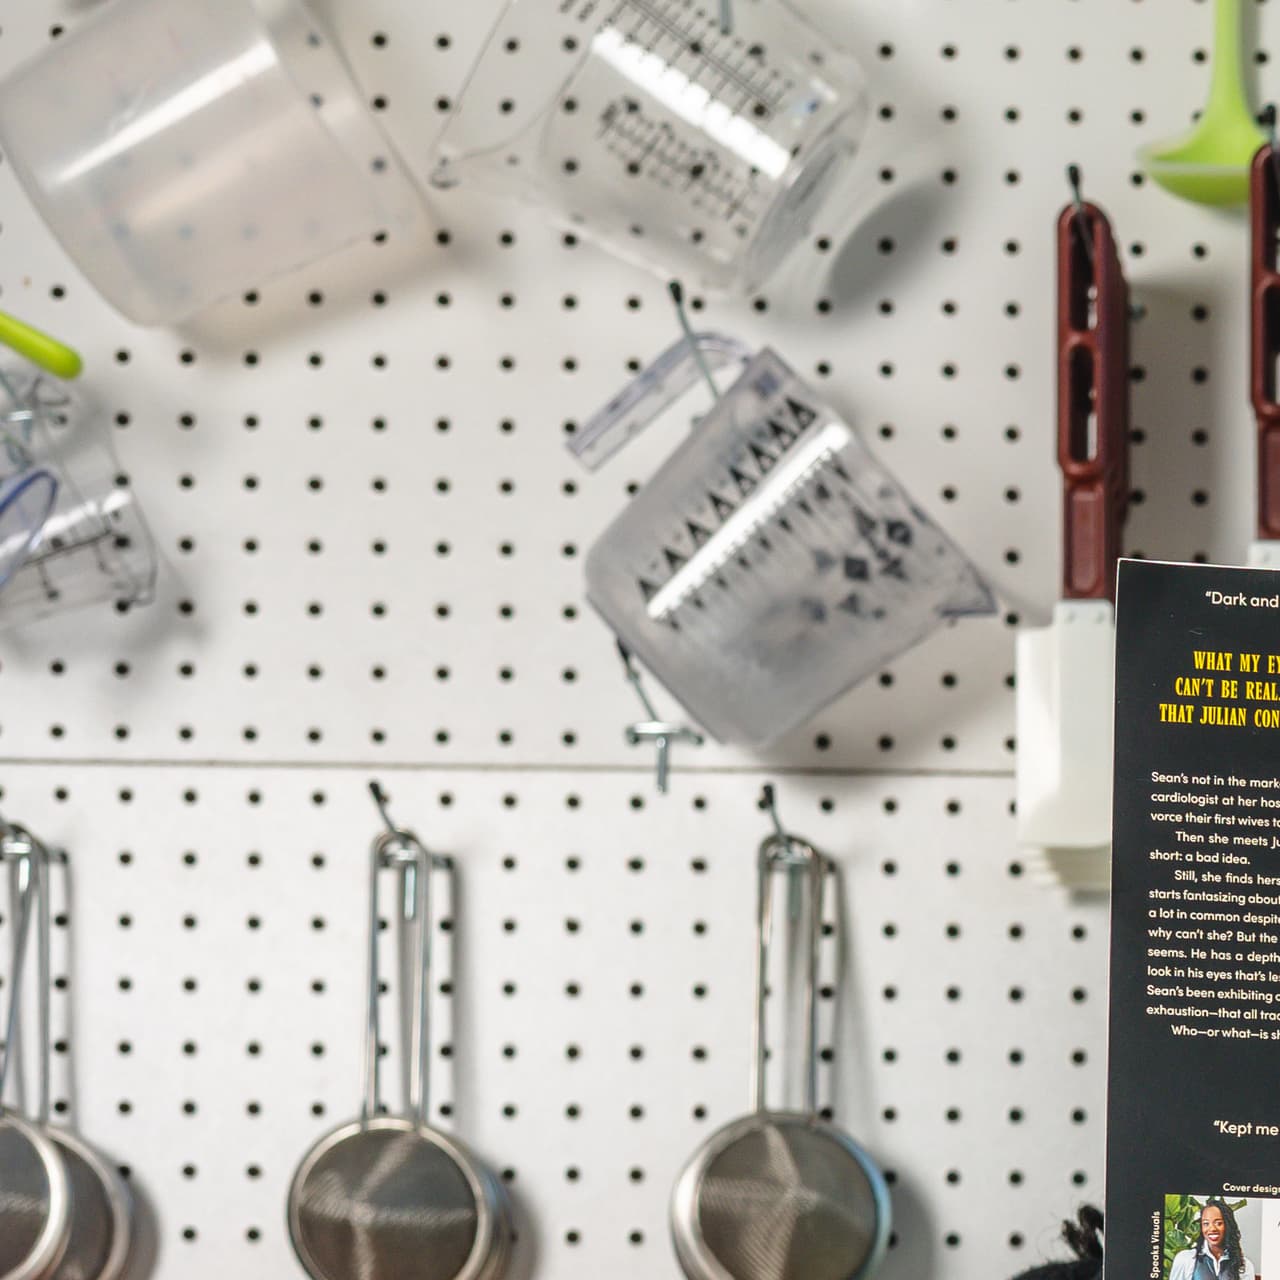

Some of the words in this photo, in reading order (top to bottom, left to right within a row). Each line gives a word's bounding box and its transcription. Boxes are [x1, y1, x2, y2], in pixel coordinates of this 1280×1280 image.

[1205, 590, 1247, 606] “Dark
[1250, 594, 1279, 608] and
[1193, 650, 1233, 672] WHAT
[1239, 653, 1261, 673] MY
[1175, 677, 1214, 698] CAN’T
[1220, 679, 1238, 699] BE
[1159, 703, 1195, 724] THAT
[1199, 705, 1247, 727] JULIAN
[1151, 771, 1189, 784] Sean’s
[1191, 775, 1211, 785] not
[1213, 775, 1225, 786] in
[1227, 775, 1247, 787] the
[1213, 1120, 1253, 1138] “Kept
[1255, 1125, 1279, 1136] me
